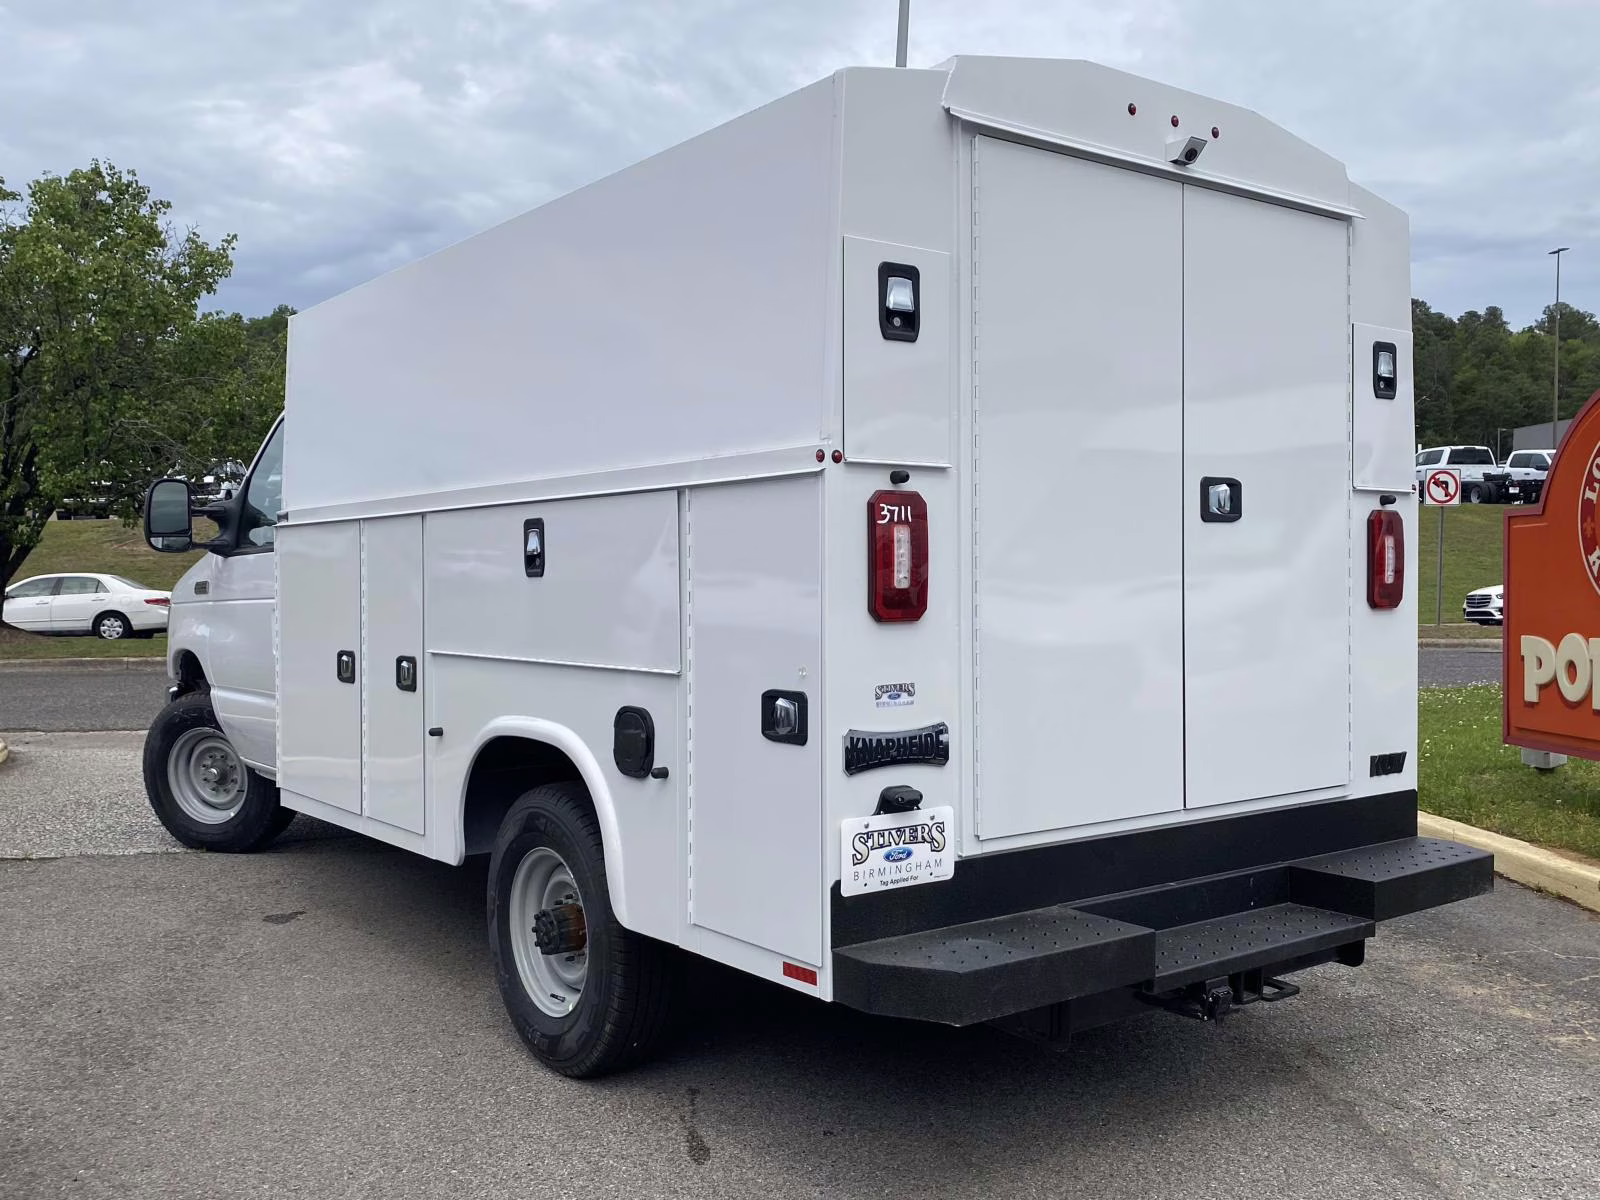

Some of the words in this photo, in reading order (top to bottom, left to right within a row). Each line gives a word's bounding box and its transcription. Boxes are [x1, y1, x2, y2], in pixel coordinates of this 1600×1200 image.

[877, 503, 912, 524] 3711
[875, 682, 915, 700] STIVERS
[846, 728, 945, 769] KNAPHEIDE
[852, 821, 946, 866] STIVERS
[853, 858, 943, 881] BIRMINGHAM
[880, 879, 889, 887] Tag
[889, 876, 910, 886] Applied
